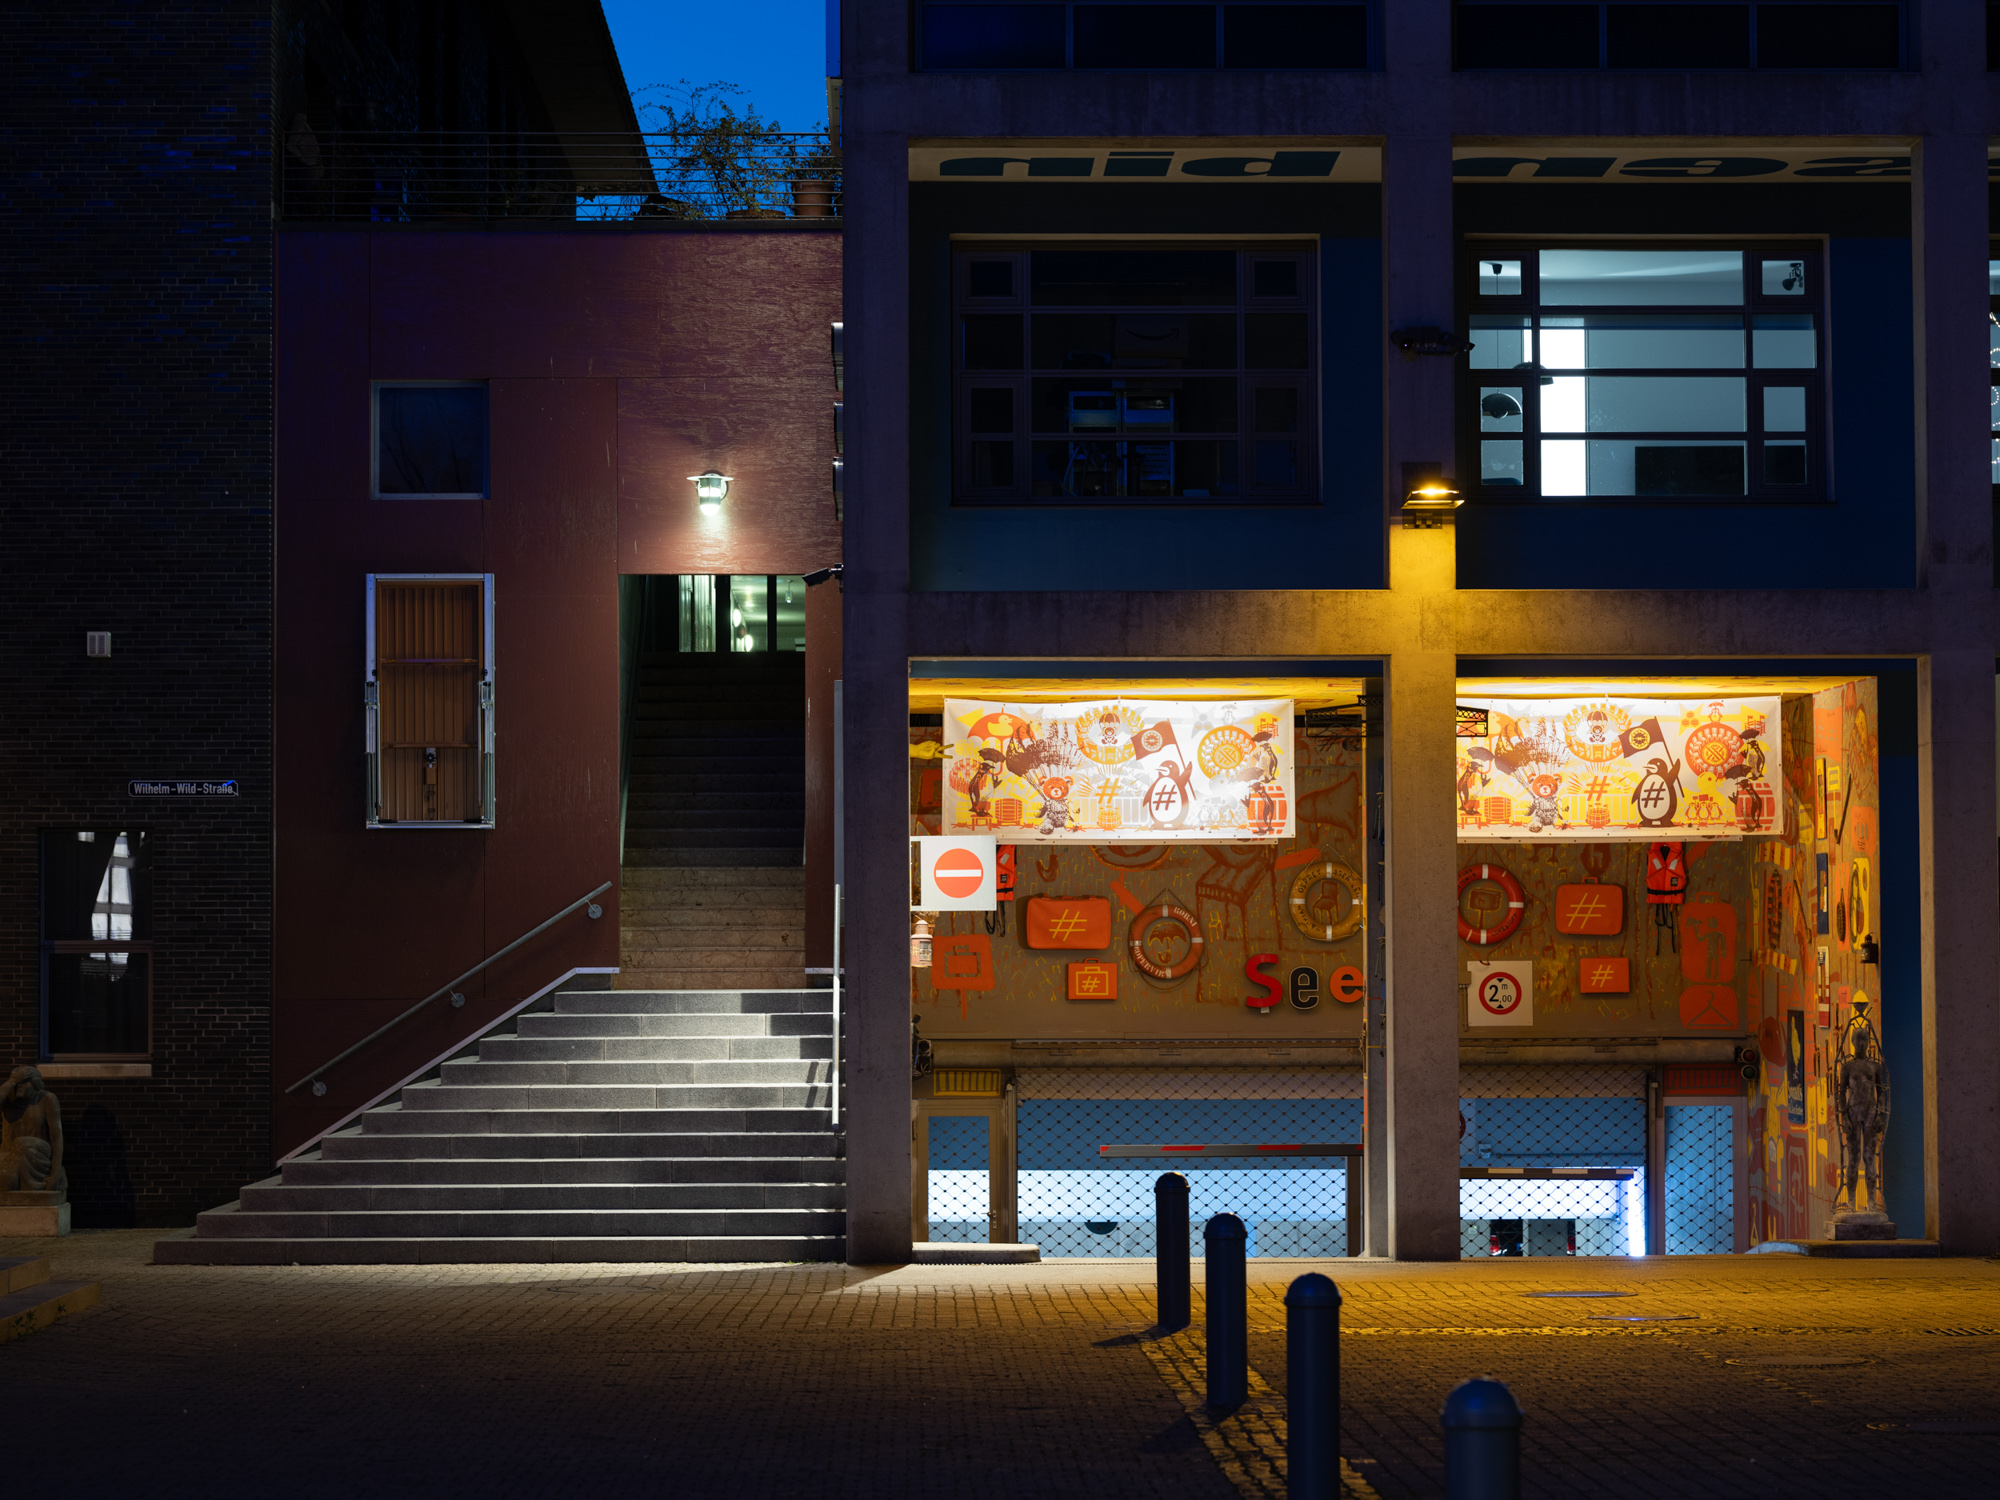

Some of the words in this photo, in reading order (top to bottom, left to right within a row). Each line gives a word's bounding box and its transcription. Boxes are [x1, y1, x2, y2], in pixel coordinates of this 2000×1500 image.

[133, 782, 234, 795] Wilhelm-Wild-Straße
[1298, 869, 1321, 894] OSPREY
[1245, 953, 1364, 1010] See
